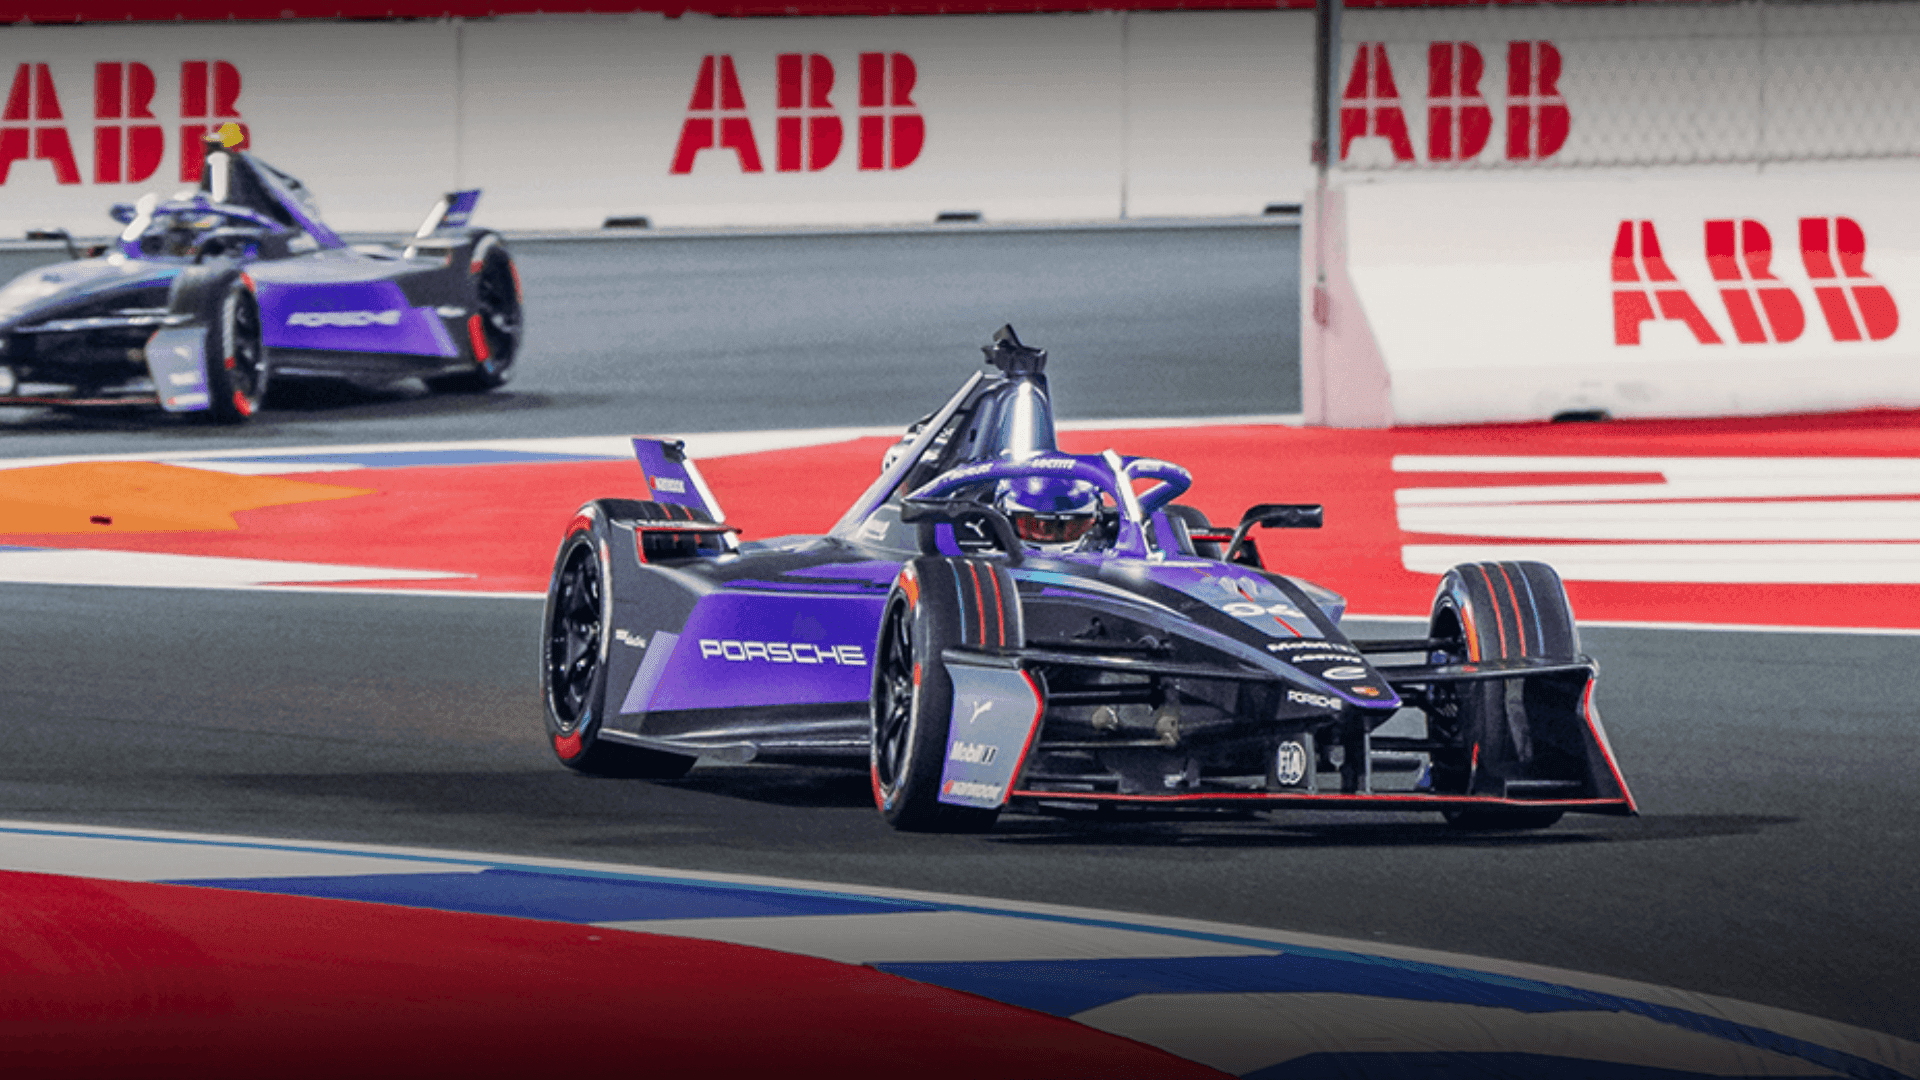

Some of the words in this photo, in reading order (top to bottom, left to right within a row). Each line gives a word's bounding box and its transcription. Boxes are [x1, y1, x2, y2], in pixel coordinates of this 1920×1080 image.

[0, 60, 250, 185] ABB
[668, 52, 925, 175] ABB
[1340, 40, 1571, 162] ABB
[1611, 216, 1900, 346] ABB
[699, 639, 867, 666] PORSCHE
